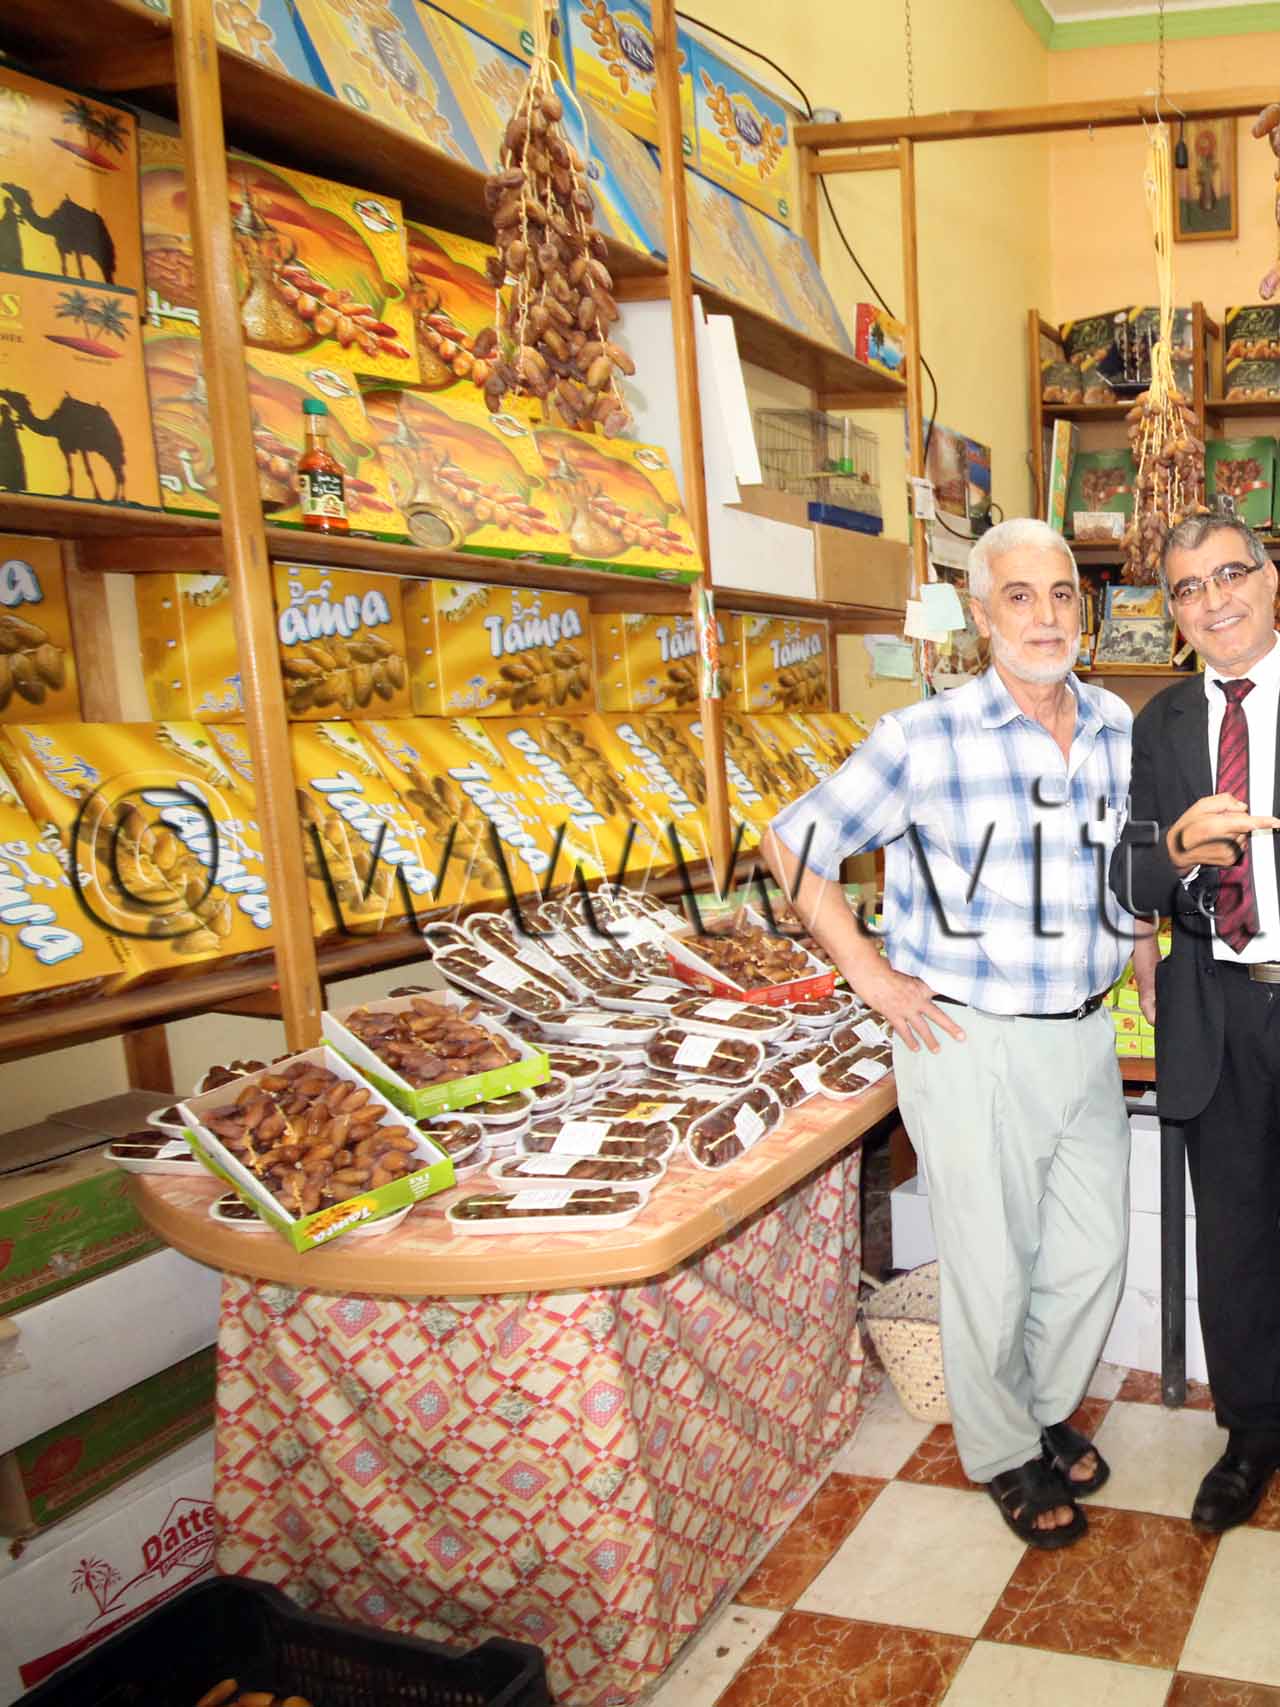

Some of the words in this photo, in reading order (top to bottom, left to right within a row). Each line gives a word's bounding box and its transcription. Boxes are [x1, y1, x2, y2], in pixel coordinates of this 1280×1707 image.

[279, 590, 391, 645] amra
[484, 608, 582, 658] Tamra
[656, 623, 726, 663] Tama
[770, 633, 823, 670] Tamra
[507, 728, 606, 832] Tamra
[310, 769, 437, 896] Tamra
[448, 760, 551, 874] Tamra
